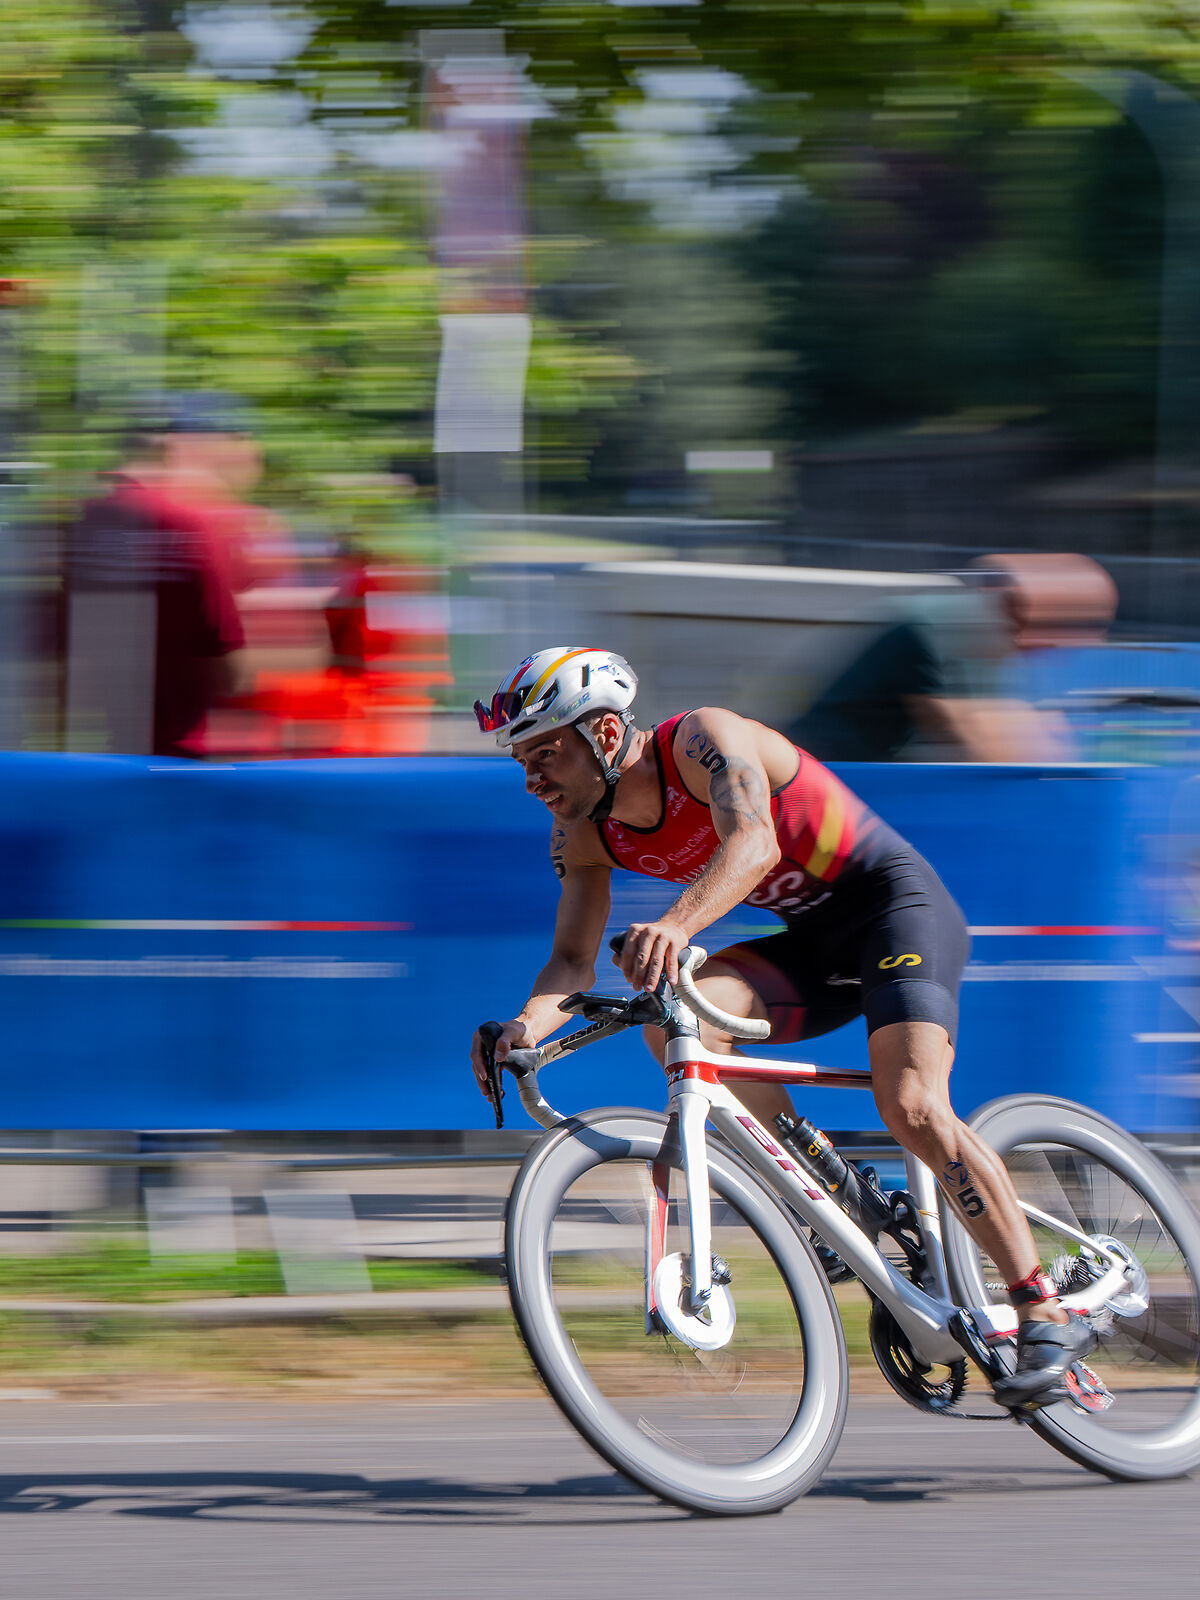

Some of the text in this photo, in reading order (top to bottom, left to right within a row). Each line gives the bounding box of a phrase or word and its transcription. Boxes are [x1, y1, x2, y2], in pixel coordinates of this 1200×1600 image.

[699, 746, 728, 776] 5
[735, 1115, 825, 1200] BH
[957, 1186, 985, 1218] 5
